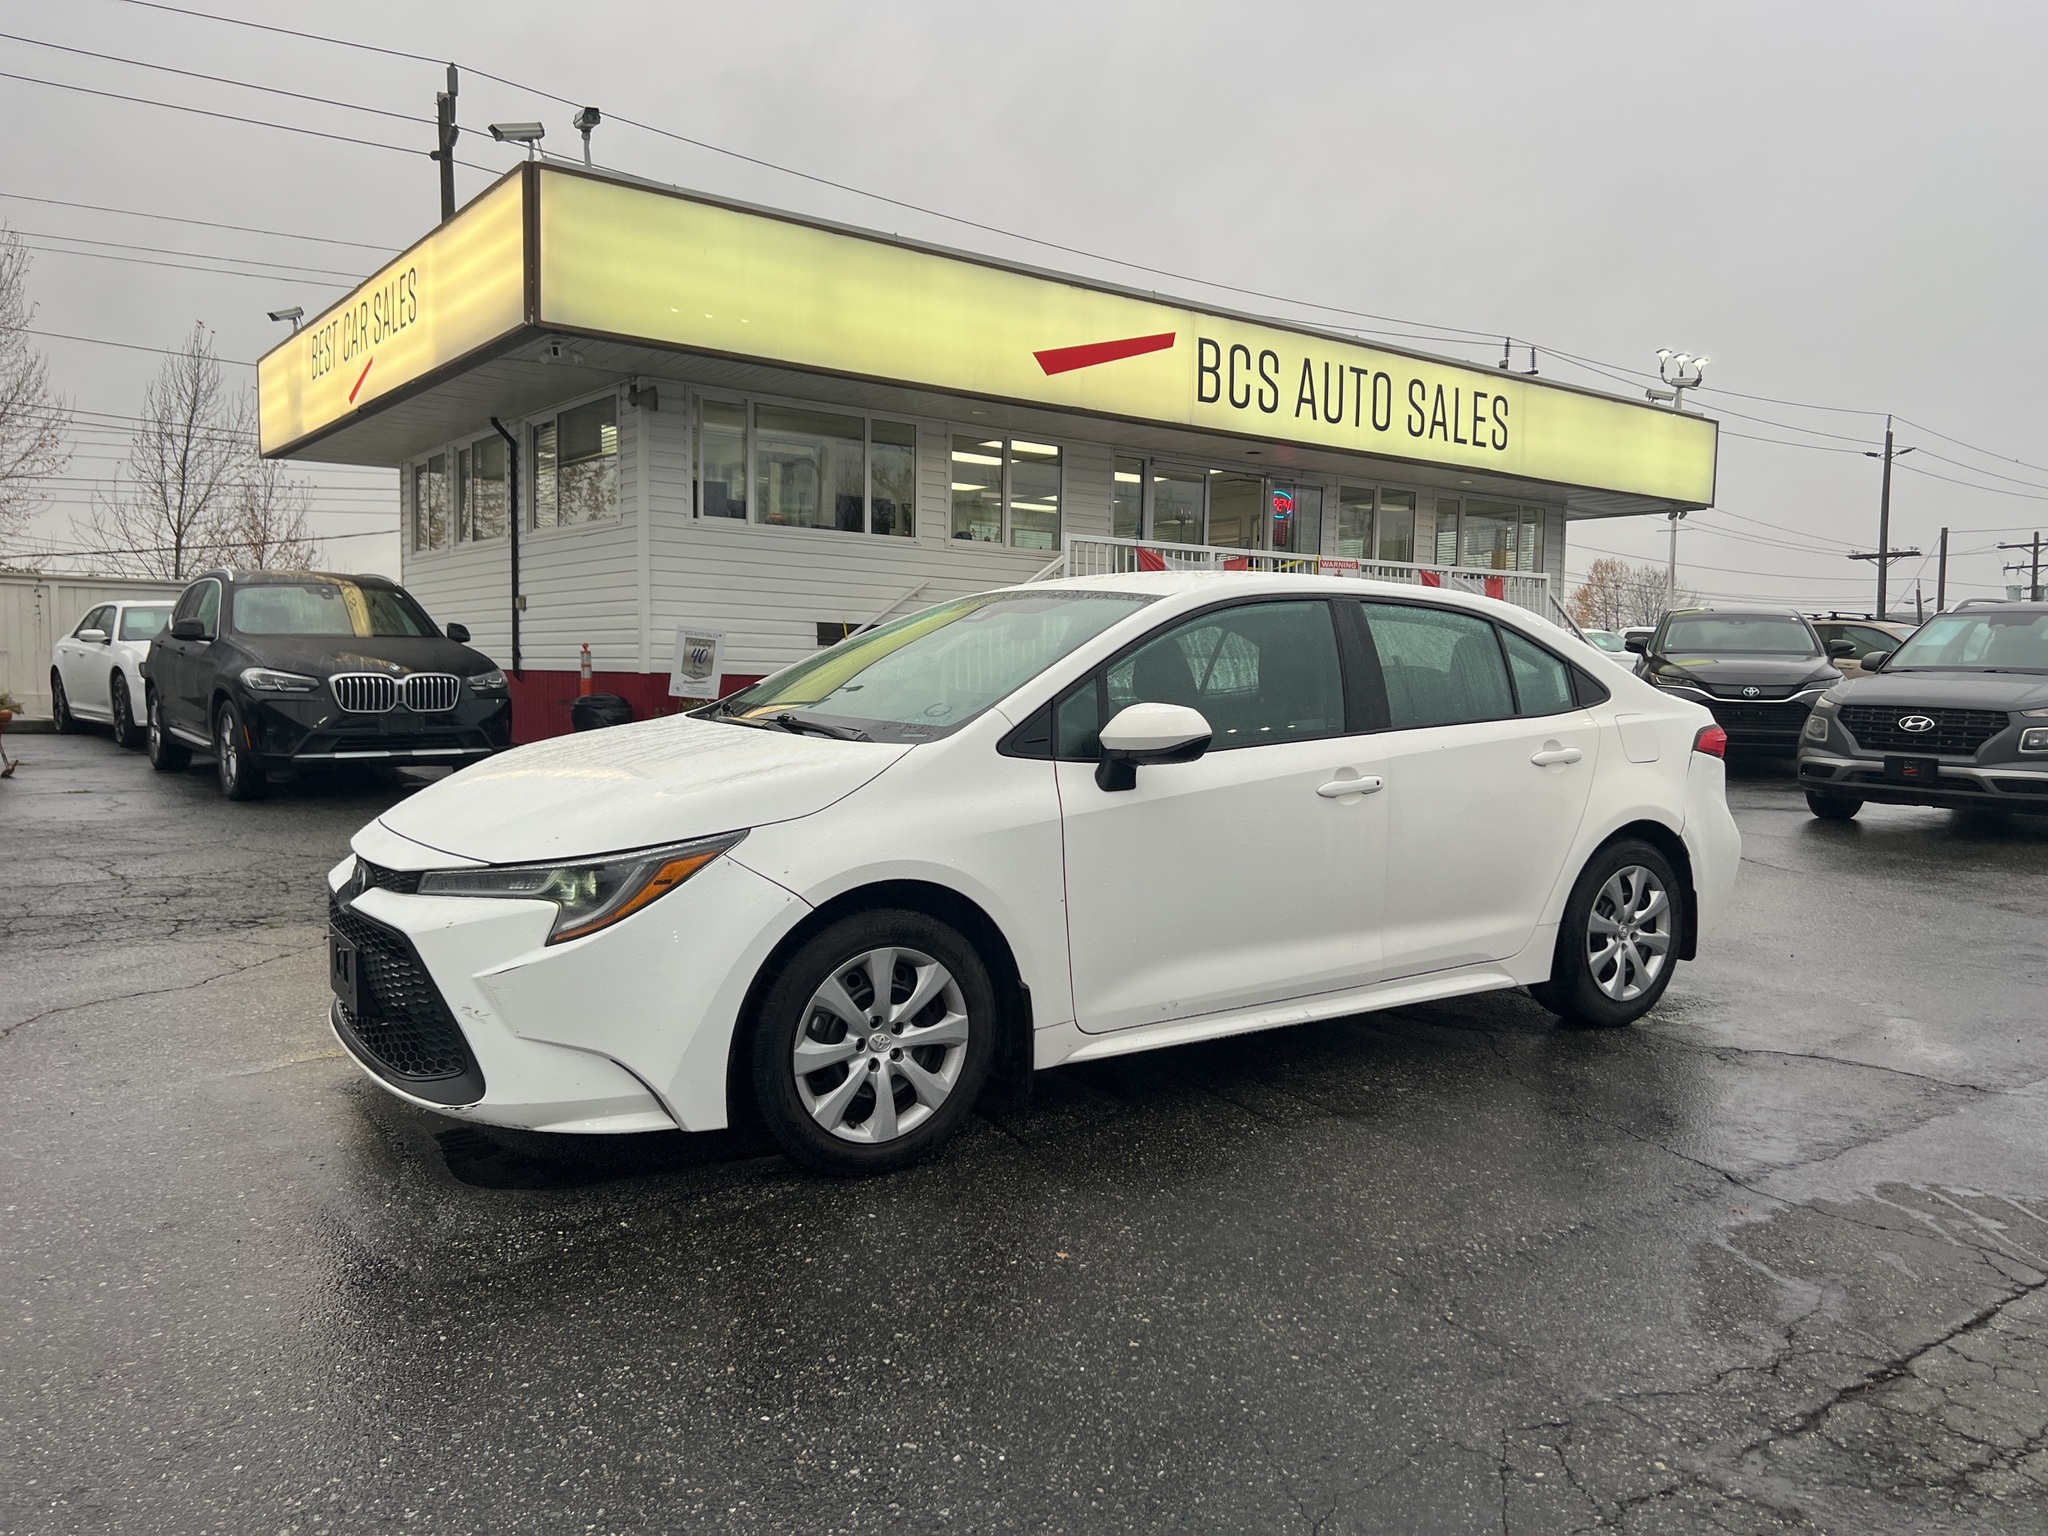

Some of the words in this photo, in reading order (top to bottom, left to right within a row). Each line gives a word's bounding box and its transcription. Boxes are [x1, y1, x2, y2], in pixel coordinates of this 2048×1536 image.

[312, 320, 338, 381] BEST
[343, 301, 368, 362] CAR
[373, 267, 417, 345] SALES
[1196, 337, 1280, 414] BCS
[1295, 357, 1392, 431] AUTO
[1407, 378, 1509, 451] SALES
[1273, 497, 1293, 512] PEN
[1320, 561, 1357, 569] WARNING
[691, 648, 709, 664] 40
